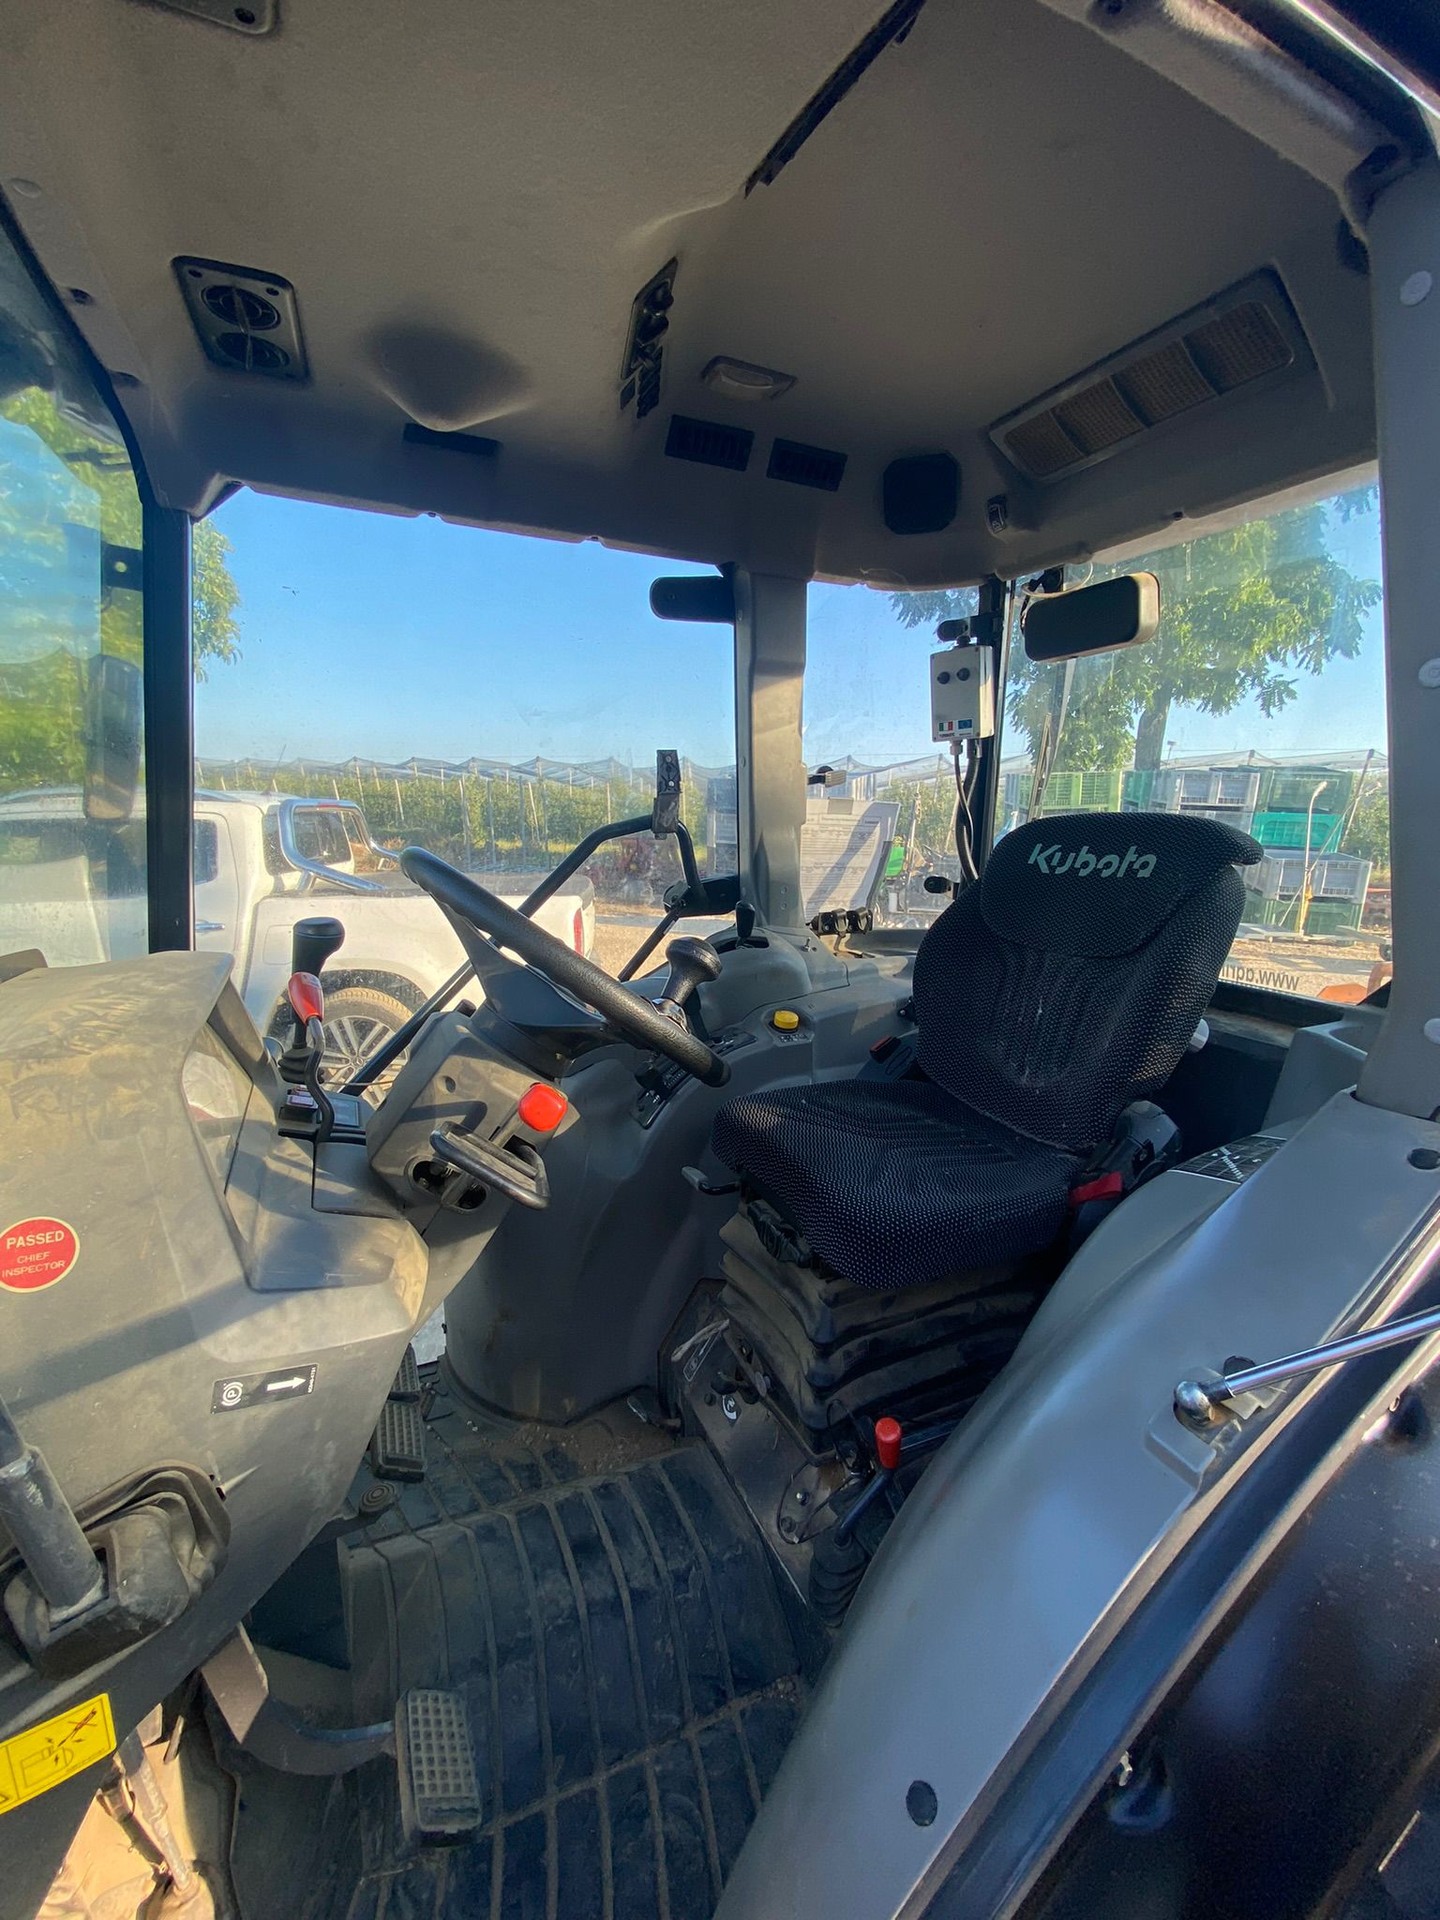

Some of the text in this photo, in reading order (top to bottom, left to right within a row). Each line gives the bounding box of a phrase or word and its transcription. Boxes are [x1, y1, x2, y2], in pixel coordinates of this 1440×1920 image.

[1027, 843, 1157, 878] Kubota
[6, 1230, 65, 1250] PASSED
[17, 1251, 51, 1264] CHIEF
[1, 1260, 66, 1278] INSPECTOR
